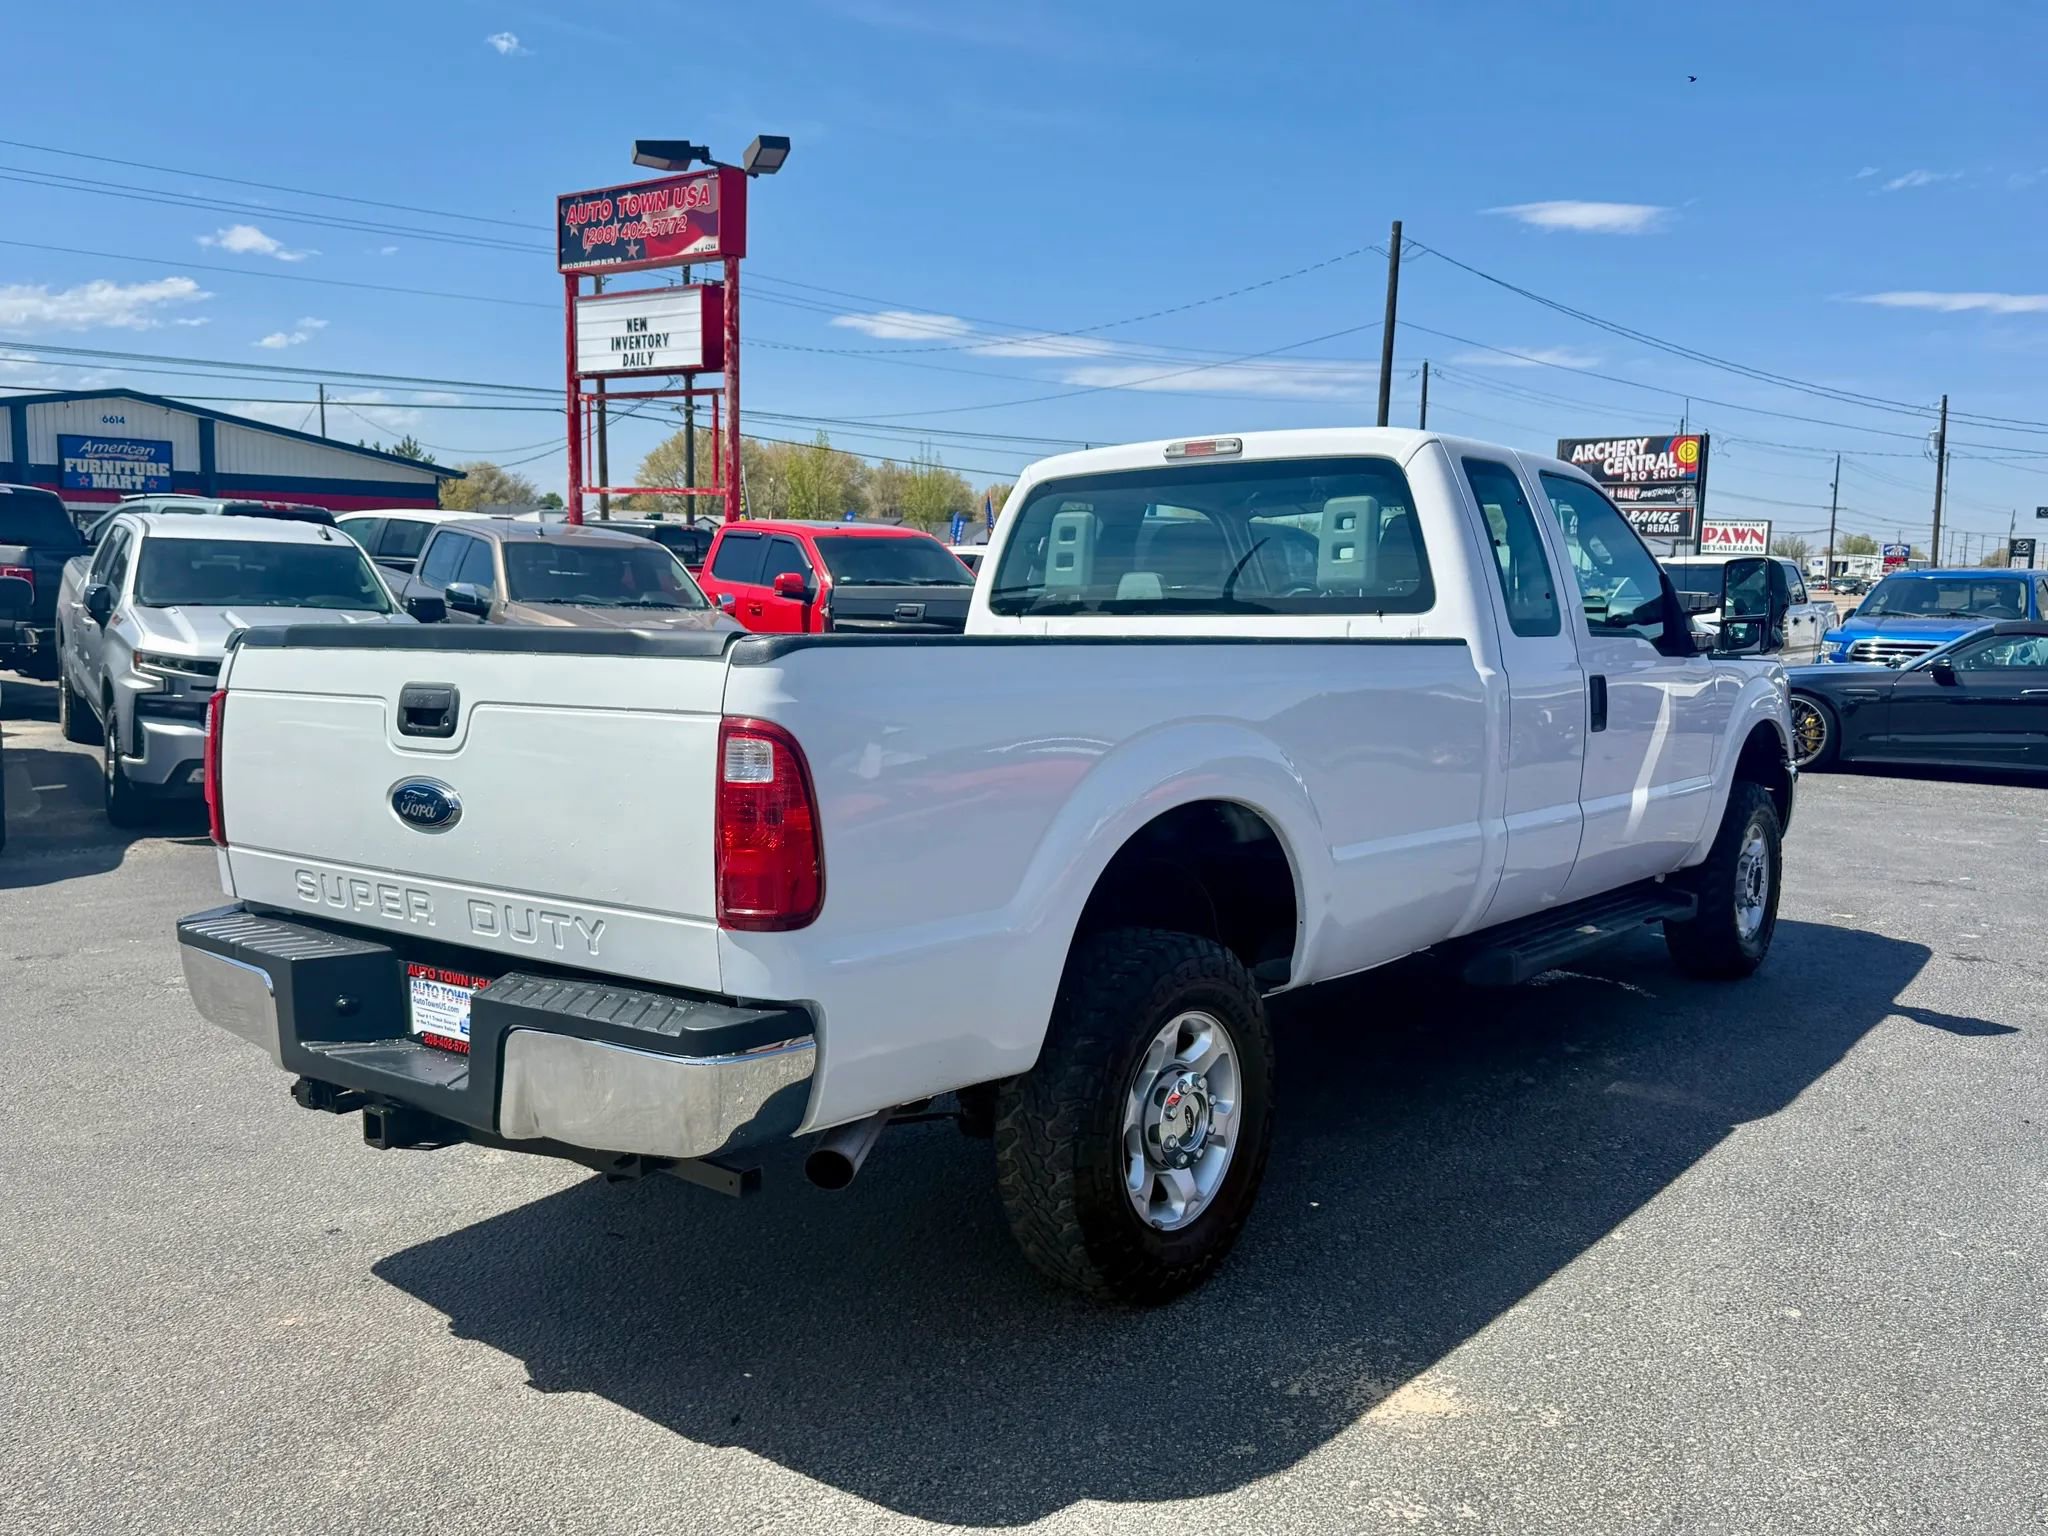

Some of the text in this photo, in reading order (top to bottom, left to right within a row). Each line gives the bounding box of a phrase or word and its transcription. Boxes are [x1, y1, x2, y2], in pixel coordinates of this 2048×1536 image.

[565, 184, 711, 226] AUTO TOWN USA
[582, 225, 618, 249] (208)
[626, 317, 648, 333] NEW
[611, 333, 670, 351] INVENTORY
[622, 352, 655, 367] DAILY
[102, 415, 125, 425] 6614
[78, 440, 156, 456] American
[1571, 438, 1650, 463] ARCHERY
[64, 457, 170, 477] FURNITURE
[1603, 451, 1678, 475] CENTRAL
[92, 474, 146, 490] MART
[1623, 467, 1686, 482] PRO SHOP
[1628, 510, 1681, 524] RANGE
[1647, 523, 1680, 533] REPAIR
[1702, 527, 1765, 545] PAWN
[401, 790, 437, 818] Ford
[294, 869, 606, 956] SUPER DUTY
[408, 964, 492, 989] AUTO TOWN USA
[412, 980, 440, 998] AUTO
